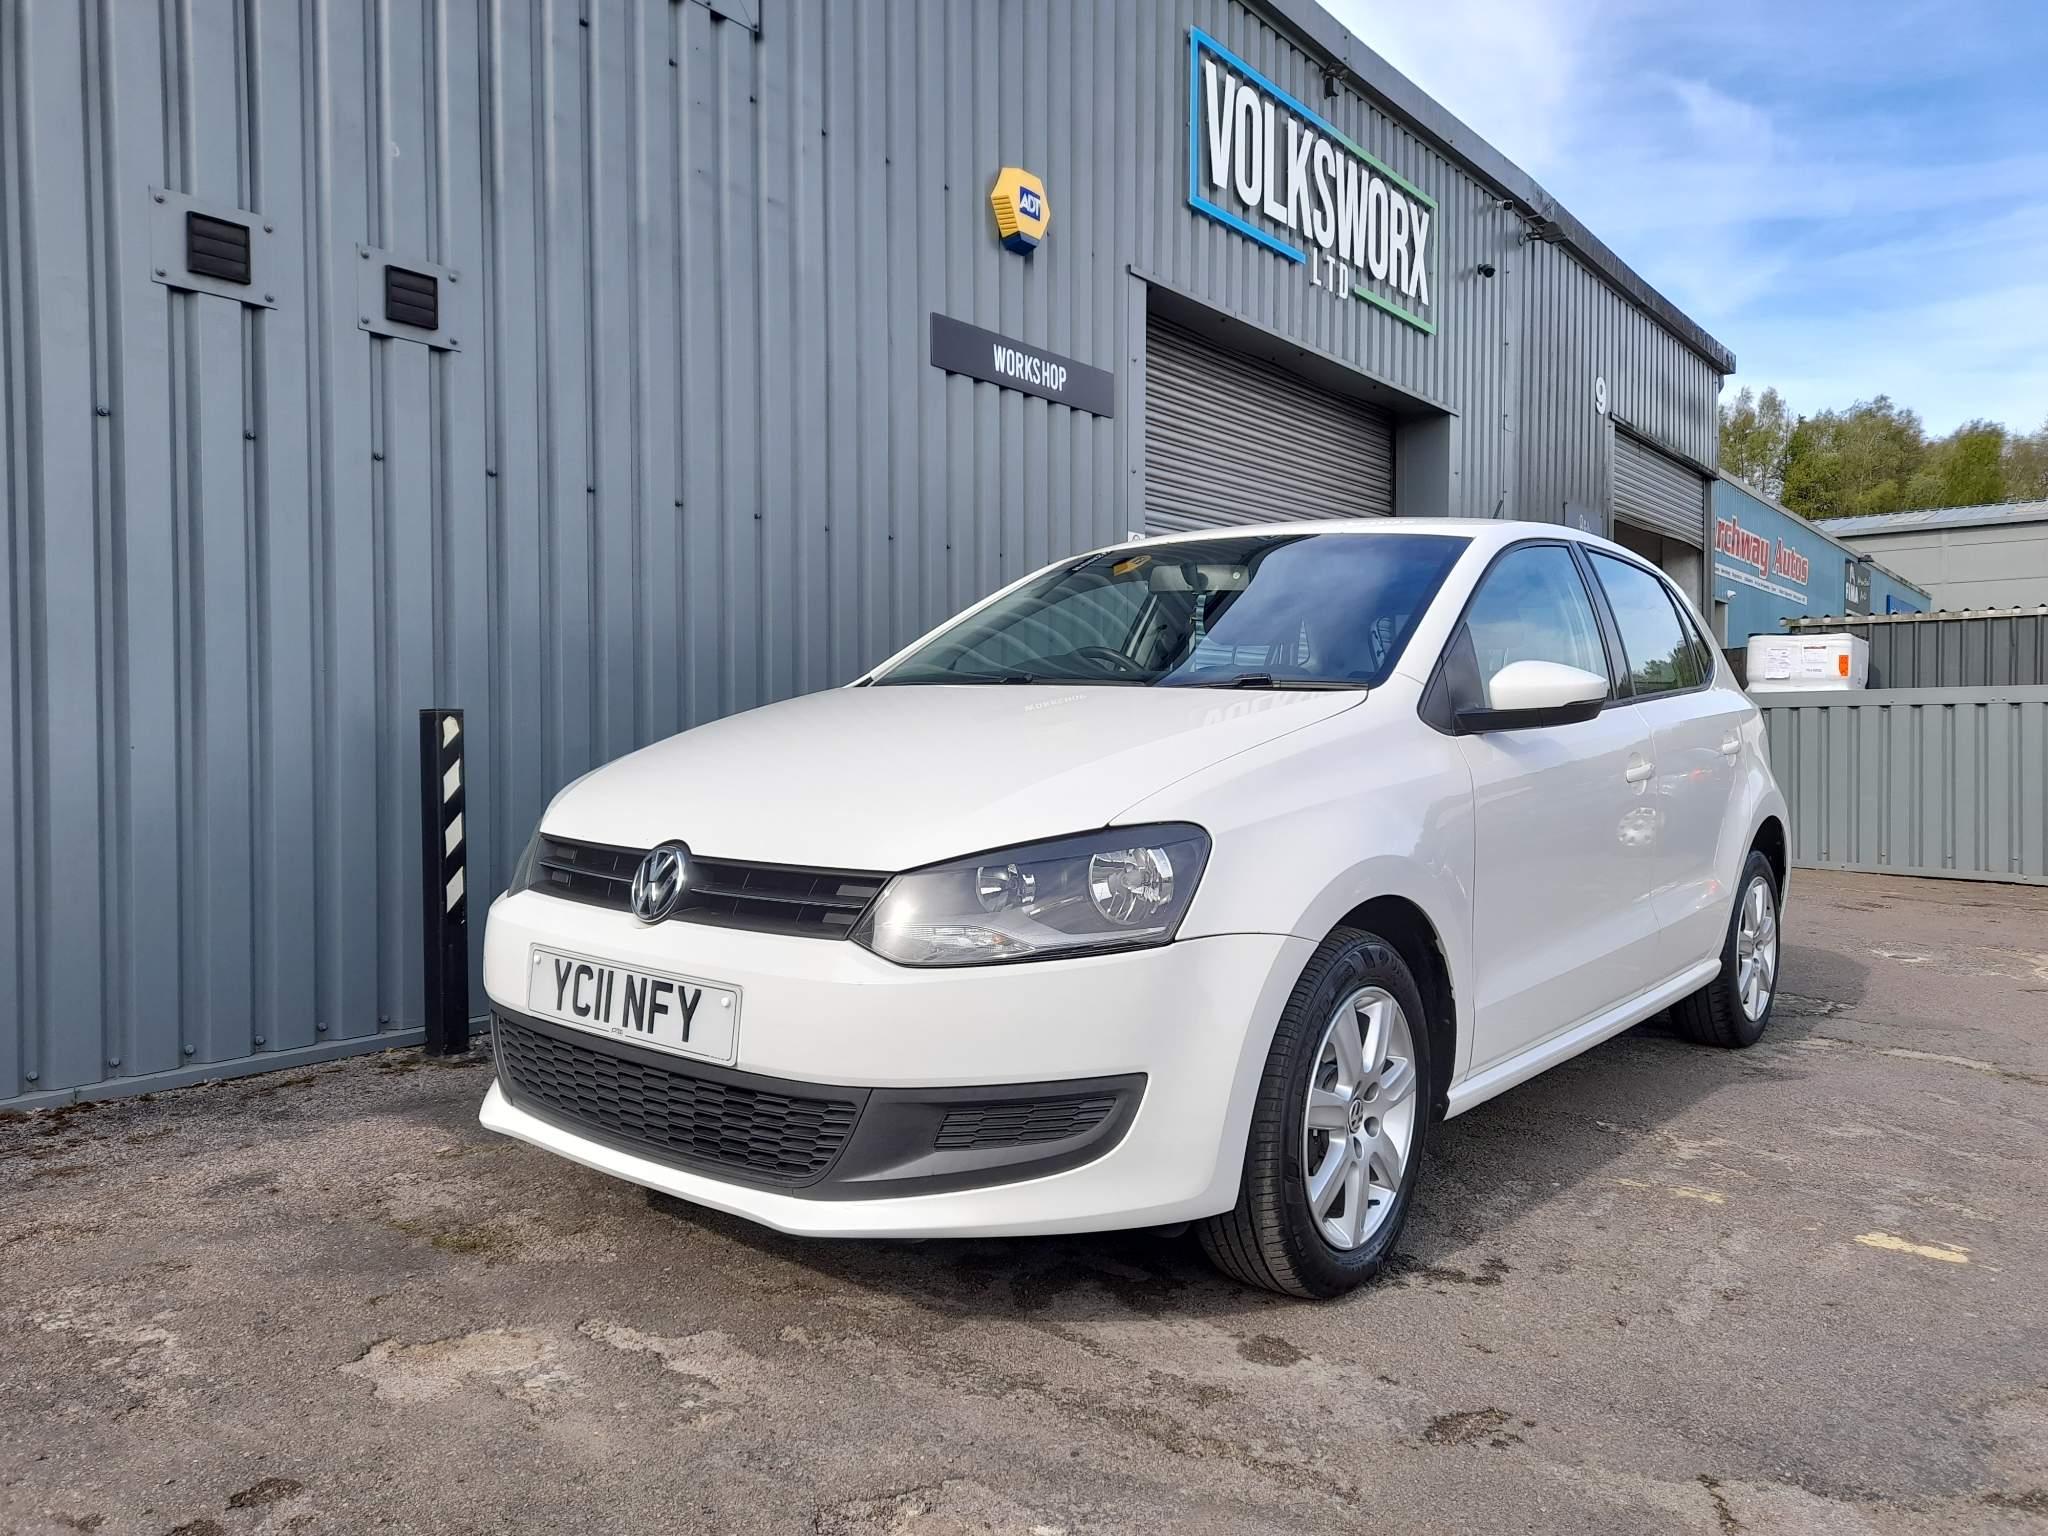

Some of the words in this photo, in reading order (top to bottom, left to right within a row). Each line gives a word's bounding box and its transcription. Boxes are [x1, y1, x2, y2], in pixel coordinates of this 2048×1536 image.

[1020, 191, 1041, 216] ADT
[1205, 59, 1429, 305] VOLKSWORX
[1312, 247, 1348, 300] LTD
[993, 343, 1067, 392] WORKSHOP
[1595, 376, 1606, 415] 9
[1715, 515, 1769, 579] rchway
[1772, 536, 1808, 585] Autos
[554, 958, 614, 1023] YC11
[622, 974, 702, 1043] NFY
